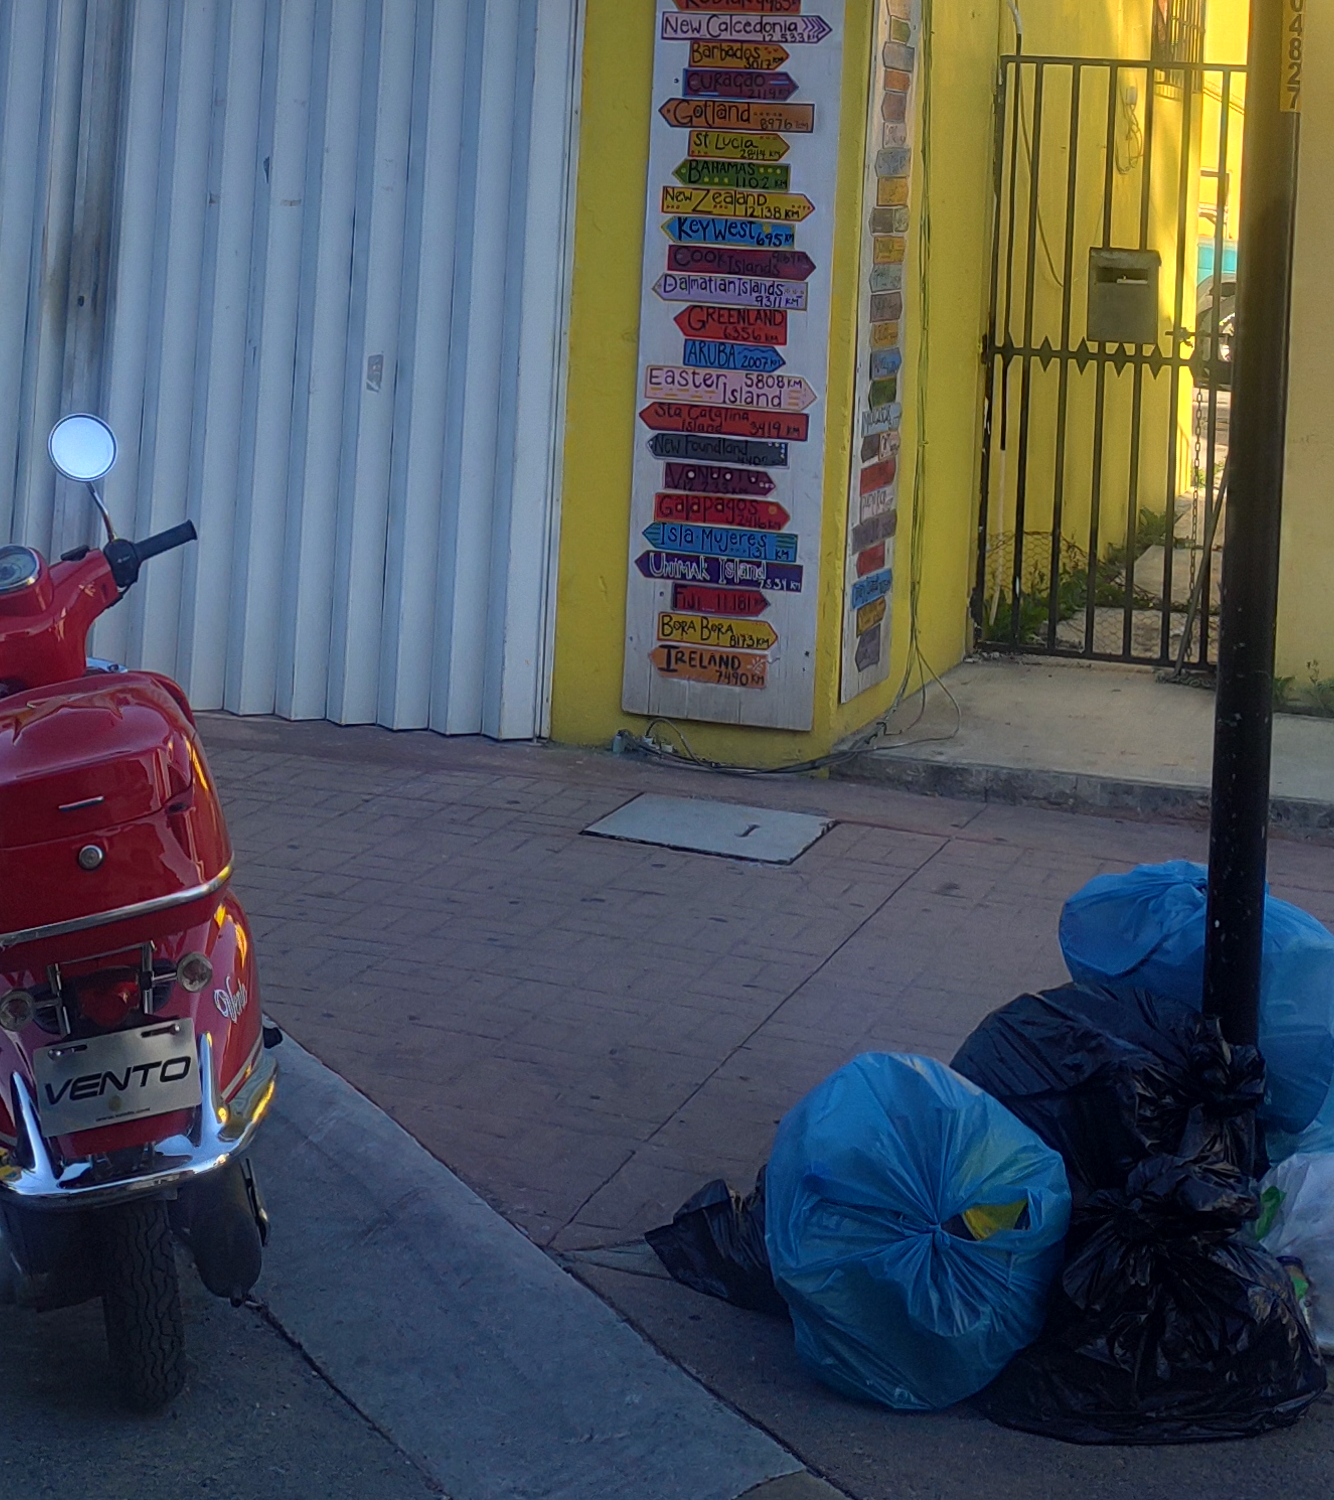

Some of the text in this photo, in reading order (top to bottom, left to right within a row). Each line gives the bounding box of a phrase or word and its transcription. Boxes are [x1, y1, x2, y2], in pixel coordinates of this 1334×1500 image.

[664, 14, 798, 38] New Calcedonia
[691, 42, 761, 63] Barbados
[673, 100, 751, 127] Gotland
[715, 134, 759, 150] Lucia
[689, 160, 755, 184] BAHAMAS
[666, 189, 693, 204] New
[756, 232, 784, 247] 695
[687, 307, 784, 332] GREENLAND
[687, 341, 737, 367] ARUBA
[741, 355, 768, 368] 2007
[649, 367, 728, 390] Easter
[744, 372, 786, 390] 5808
[722, 381, 782, 408] Island
[749, 421, 781, 436] 3419
[660, 522, 767, 553] Isla Mujeres
[657, 644, 741, 673] IRELAND
[715, 669, 747, 685] 7490
[44, 1056, 192, 1106] VENTO
